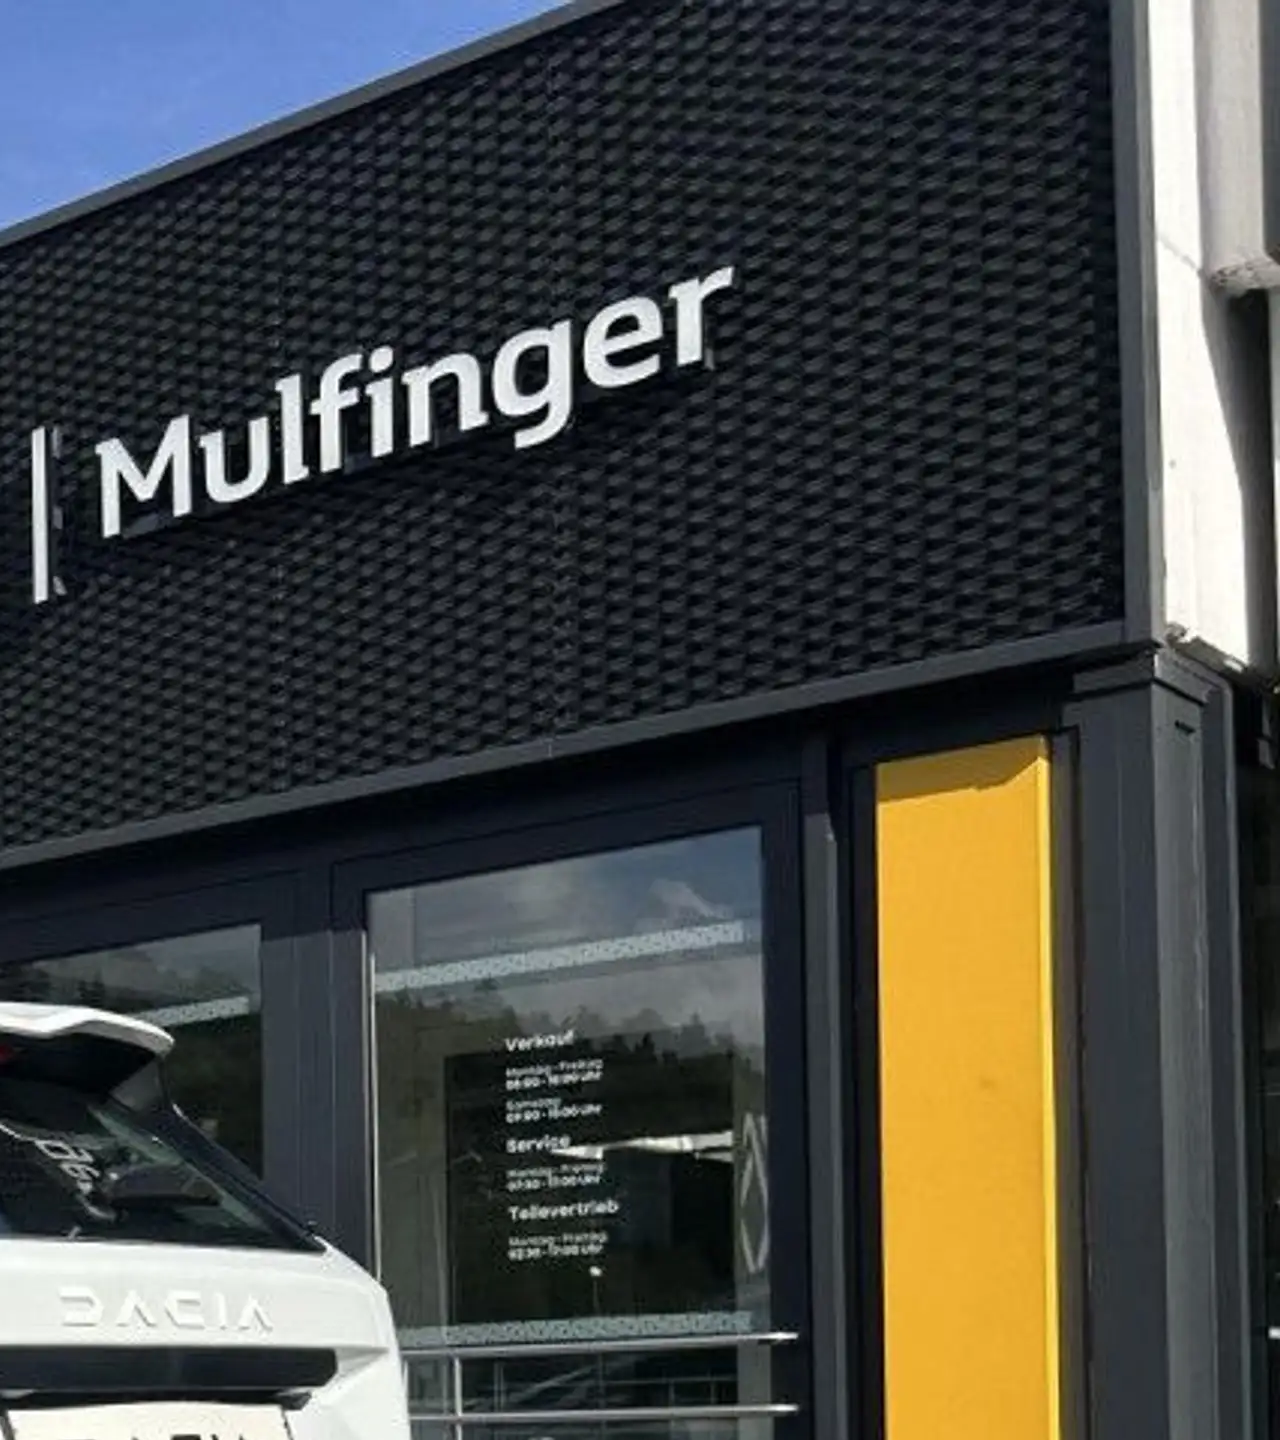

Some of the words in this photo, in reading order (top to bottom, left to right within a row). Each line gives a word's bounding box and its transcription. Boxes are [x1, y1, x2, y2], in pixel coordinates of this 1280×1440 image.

[95, 265, 734, 539] Mulfinger
[504, 1029, 575, 1052] Verkauf
[506, 1133, 571, 1154] Service
[507, 1197, 620, 1221] Teilevertrieb
[59, 1286, 275, 1333] DACIA
